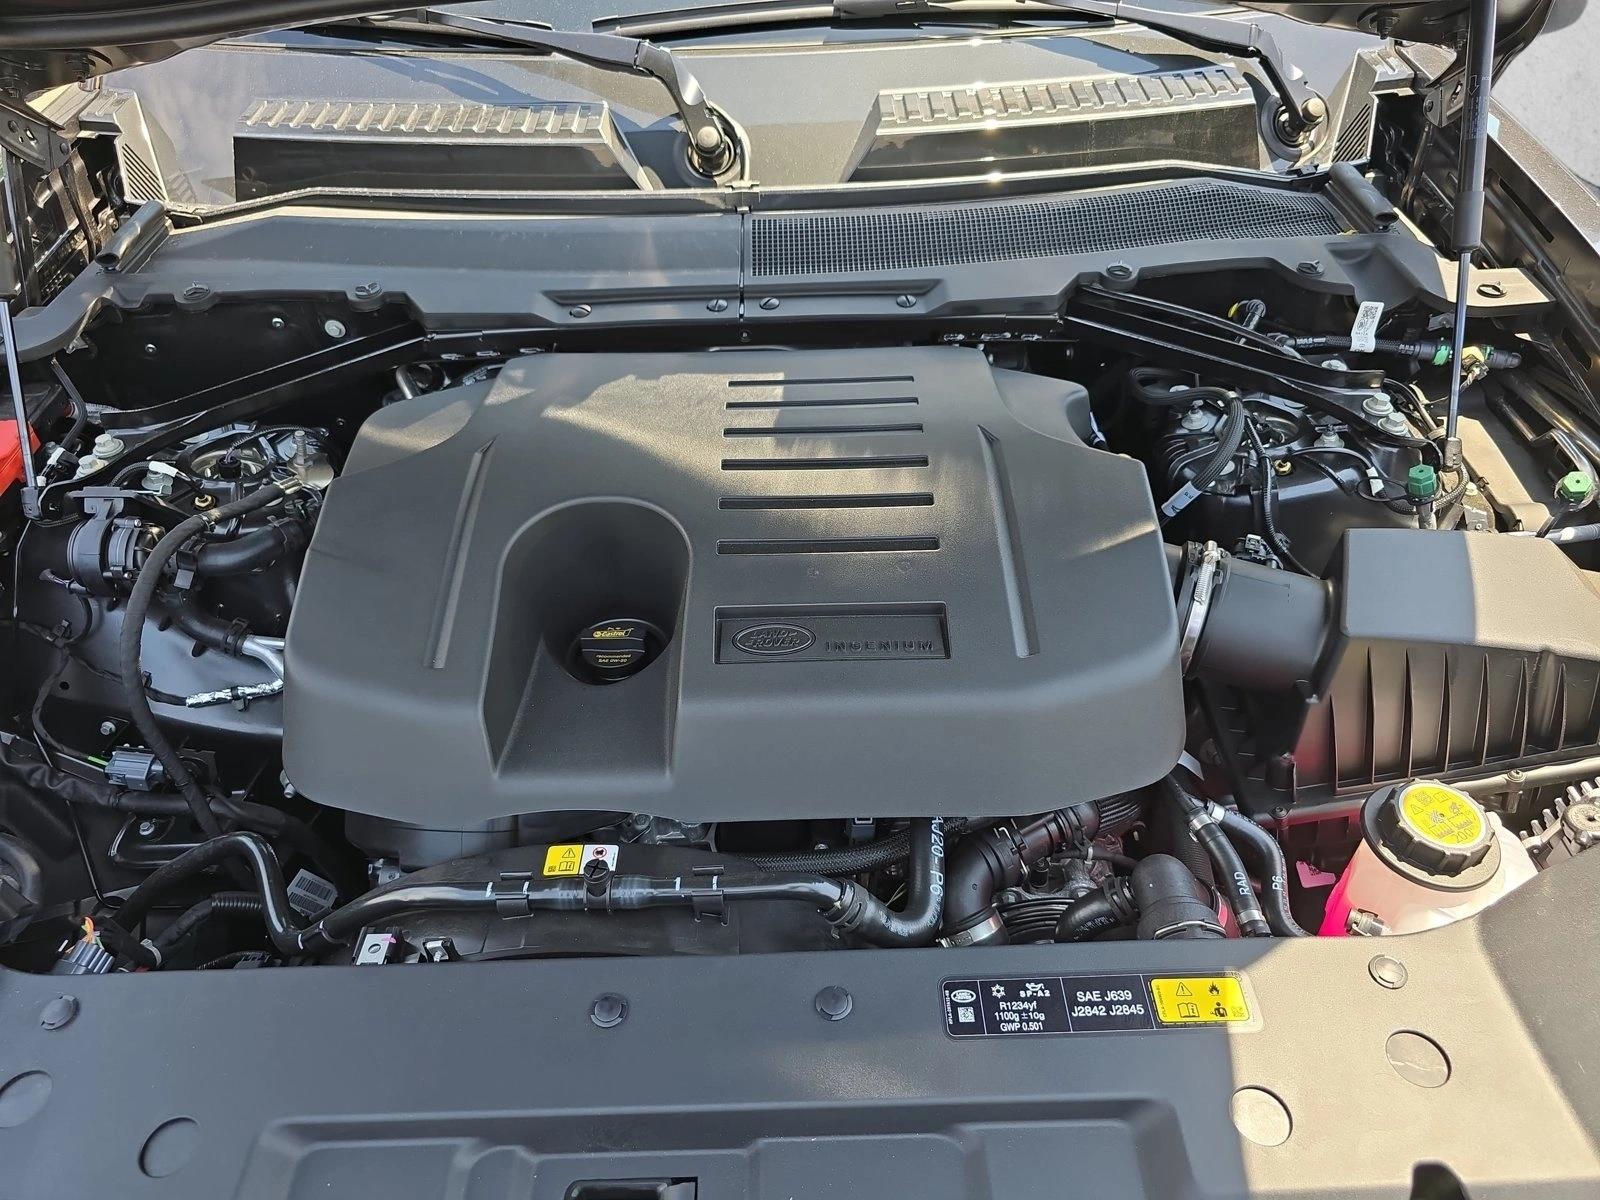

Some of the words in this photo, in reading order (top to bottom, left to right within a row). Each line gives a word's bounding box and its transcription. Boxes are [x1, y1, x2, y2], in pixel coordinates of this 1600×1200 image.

[750, 629, 789, 639] LAND
[752, 637, 800, 648] ROVER
[826, 639, 934, 652] INGENIUM
[1234, 871, 1251, 896] RAD
[1272, 875, 1283, 891] P6
[1019, 989, 1051, 998] SP-A2
[1076, 990, 1102, 1002] SAE
[1104, 989, 1133, 1002] J639
[999, 1001, 1038, 1011] R1234yf
[1071, 1005, 1108, 1017] J2842
[1109, 1004, 1145, 1016] J2845
[994, 1011, 1020, 1021] 1100g
[1000, 1022, 1021, 1032] GWP
[1021, 1021, 1044, 1031] 0.501
